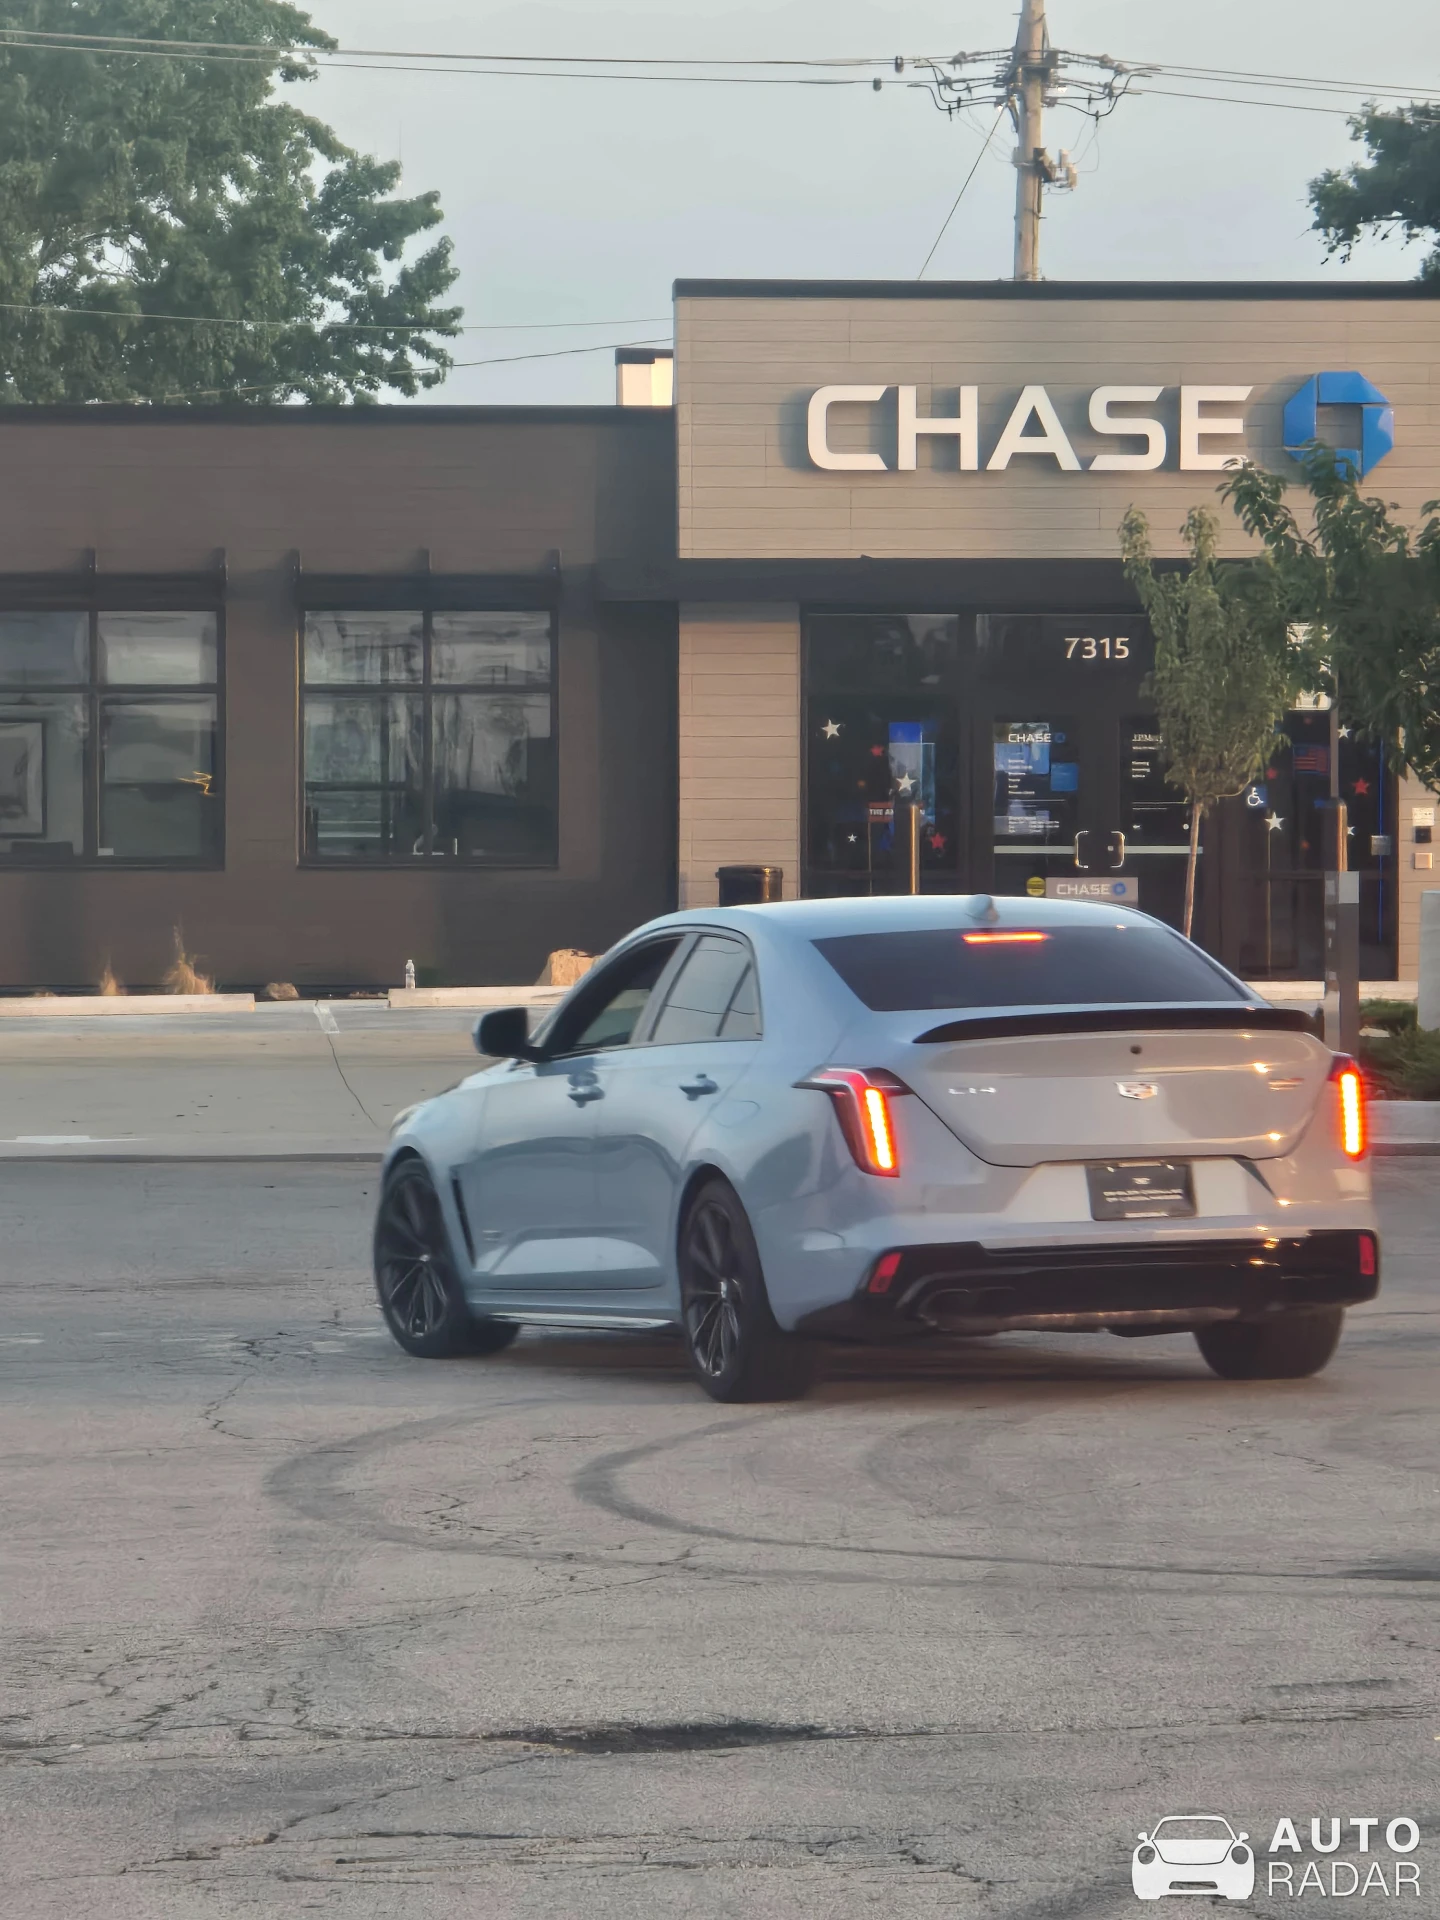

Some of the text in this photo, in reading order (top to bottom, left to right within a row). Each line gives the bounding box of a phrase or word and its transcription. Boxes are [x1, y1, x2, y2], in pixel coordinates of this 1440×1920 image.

[807, 385, 1254, 471] CHASE
[1064, 637, 1130, 659] 7315
[1008, 733, 1052, 743] CHASE
[1056, 883, 1111, 896] CHASE
